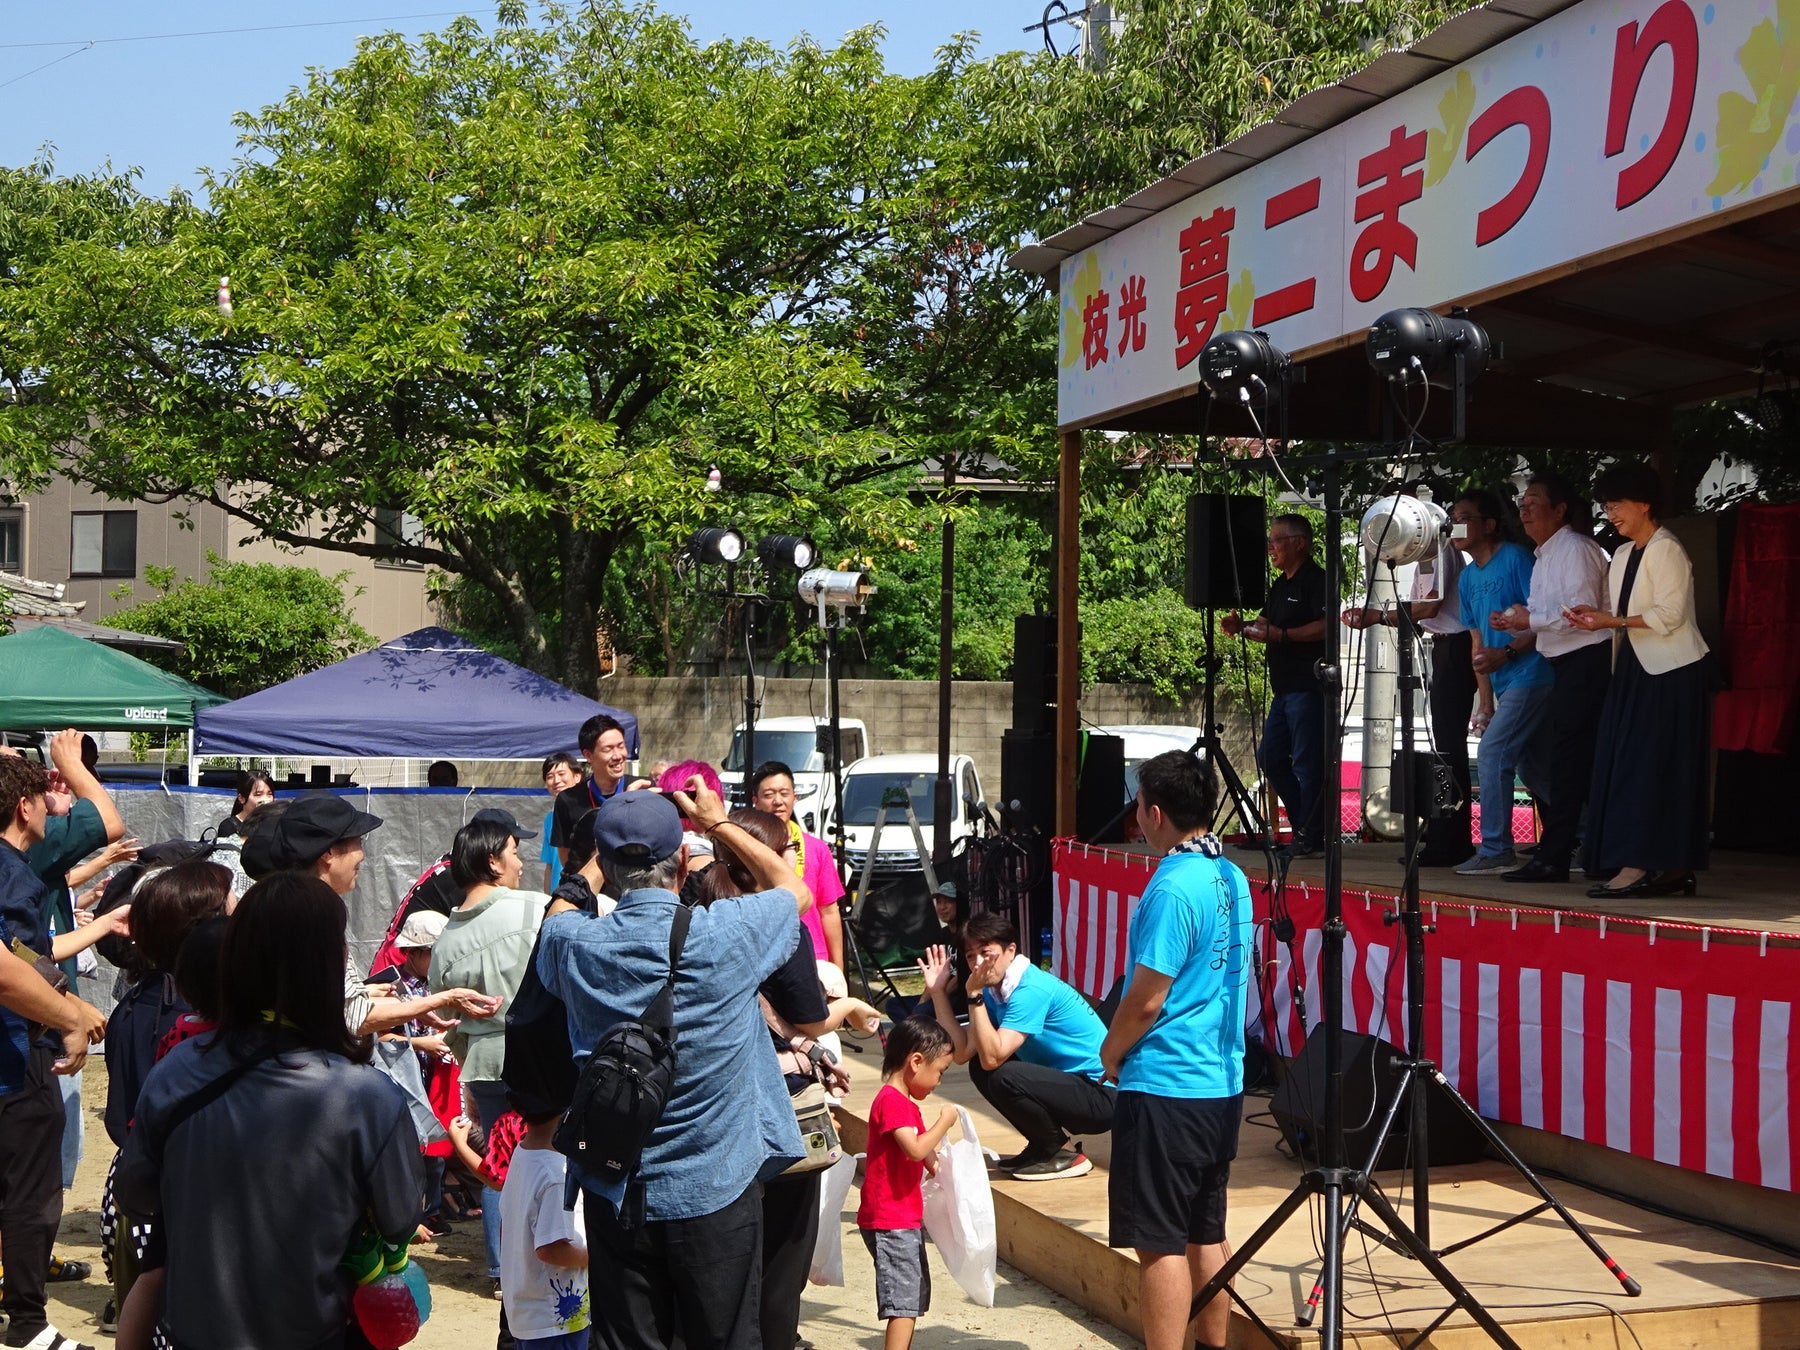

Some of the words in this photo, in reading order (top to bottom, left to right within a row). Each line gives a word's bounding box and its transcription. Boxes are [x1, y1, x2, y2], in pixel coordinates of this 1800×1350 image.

[1082, 275, 1147, 371] 枝光
[1175, 0, 1698, 370] 夢二まつり
